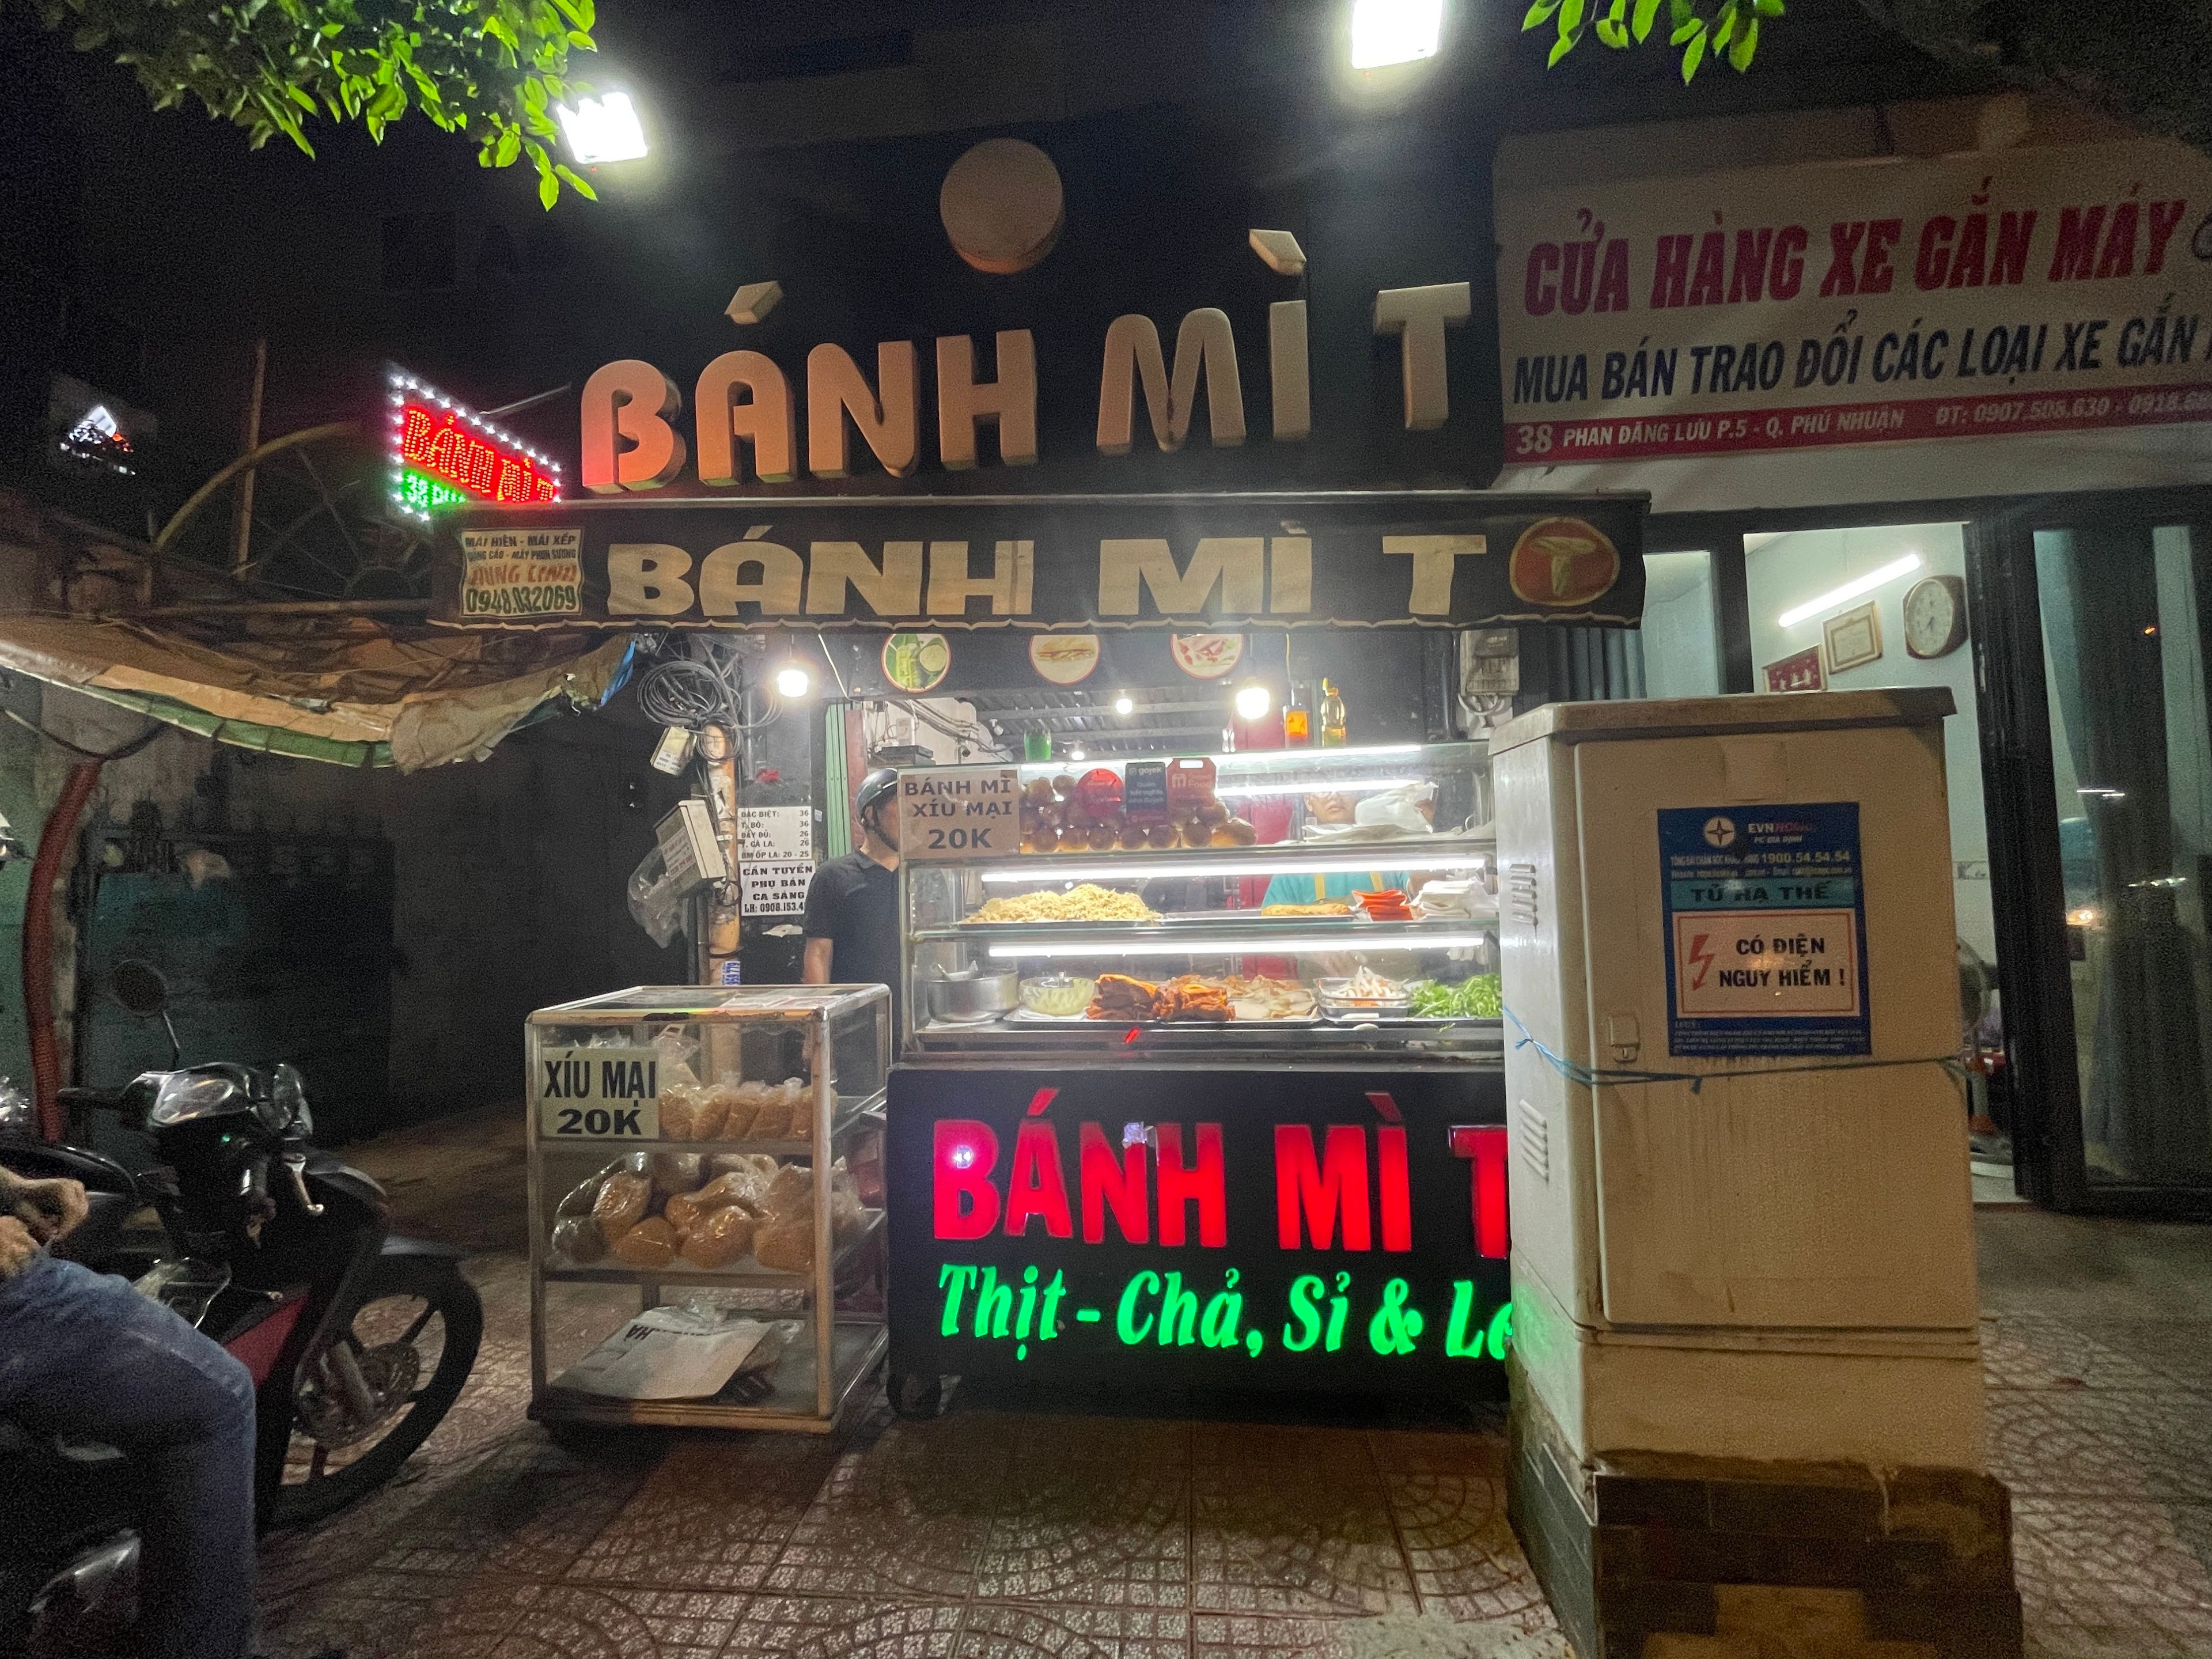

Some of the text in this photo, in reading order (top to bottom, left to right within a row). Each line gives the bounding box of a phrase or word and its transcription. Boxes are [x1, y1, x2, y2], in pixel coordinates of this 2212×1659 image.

[1524, 176, 2188, 316] CỬA HÀNG XE GẮN MÁY
[581, 229, 1472, 494] BÁNH MÌ T
[1513, 292, 2200, 404] MUA BÁN TRAO ĐỔI CÁC LOẠI XE GẮN
[1516, 425, 1552, 454] 38
[1563, 427, 1612, 448] PHAN
[1618, 421, 1669, 444] ĐĂNG
[1717, 418, 1747, 438] P.5
[1766, 416, 1783, 437] Q.
[1791, 410, 1830, 434] PHÚ
[1836, 409, 1905, 432] NHUẬN
[1936, 406, 1968, 425] ĐT:
[404, 410, 494, 495] BÁNH
[497, 459, 531, 502] MÌ
[465, 536, 488, 547] MÁI
[491, 535, 517, 547] HIÊN
[528, 533, 549, 546] MÁI
[552, 532, 576, 545] XẾP
[607, 520, 1487, 616] BÁNH MÌ T
[1138, 767, 1162, 776] gojek
[905, 775, 1011, 796] BÁNH MÌ
[912, 798, 1013, 819] XÍU MẠI
[928, 828, 992, 850] 20K
[752, 877, 805, 889] PHỤ BÁN
[772, 890, 805, 900] SÁNG
[1691, 880, 1832, 903] TỦ HẠ THẾ
[744, 903, 757, 913] LH:
[1736, 933, 1825, 957] CÓ ĐIỆN
[1719, 969, 1771, 987] NGUY
[1778, 960, 1831, 987] HIỂM
[544, 1050, 656, 1107] XÍU MẠI
[557, 1108, 642, 1135] 20K
[933, 1088, 1509, 1259] BÁNH MÌ T
[939, 1263, 1067, 1361] Thịt
[1116, 1267, 1262, 1358] Chả,
[1284, 1272, 1349, 1352] Sỉ
[1369, 1278, 1423, 1355] &
